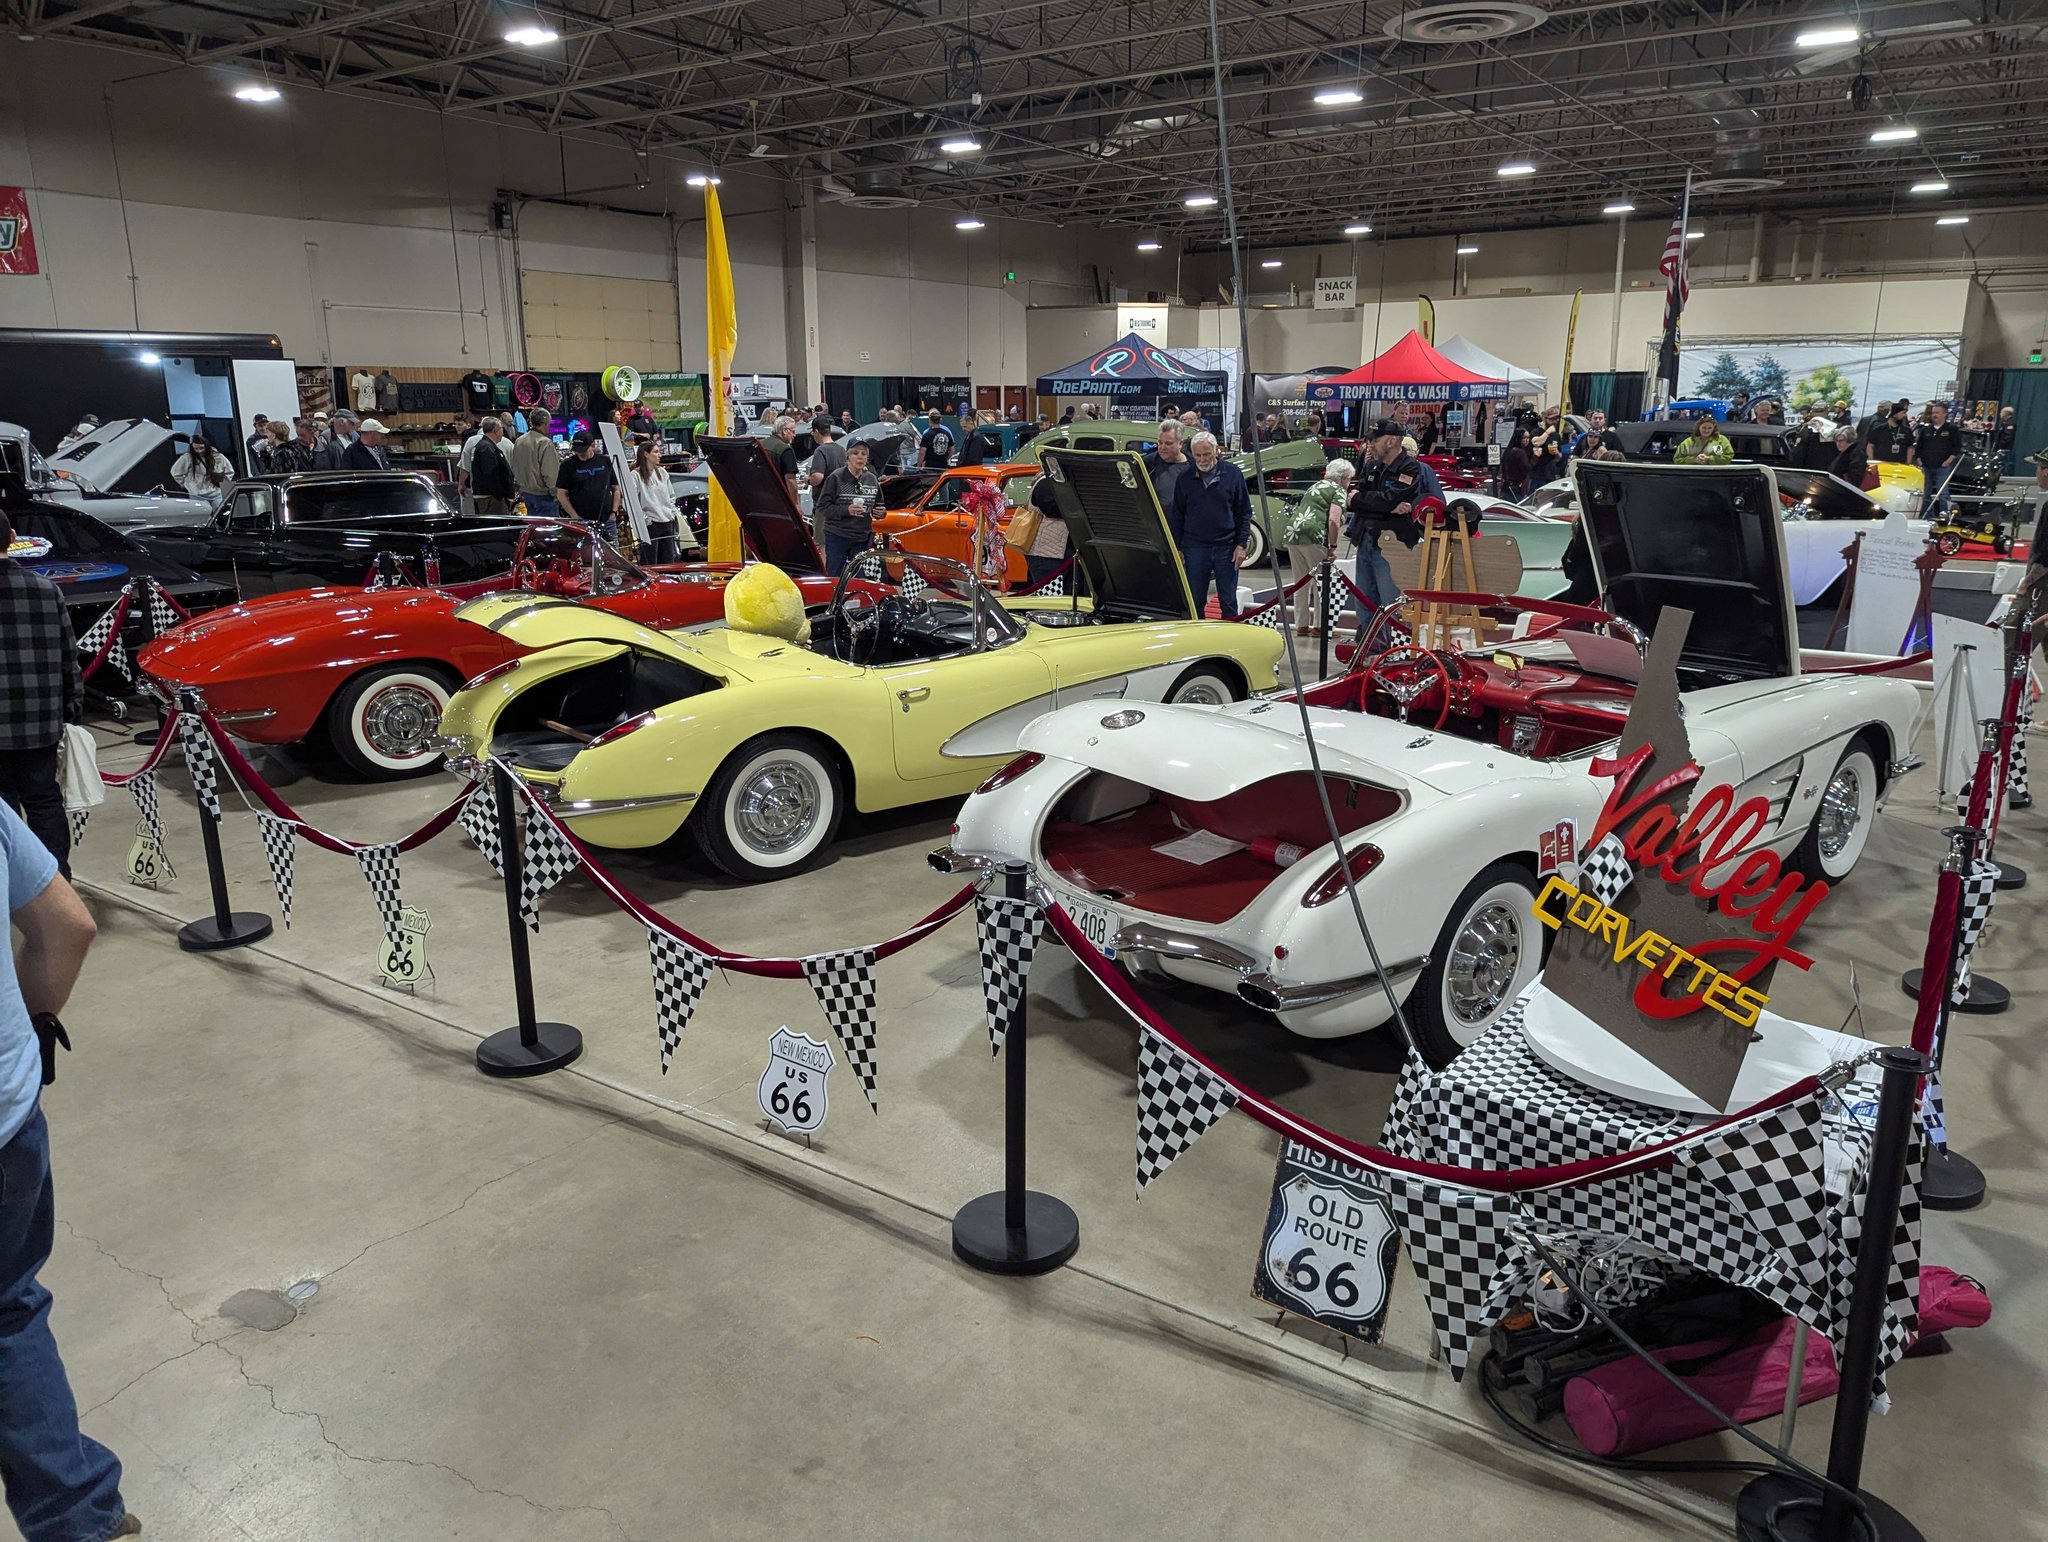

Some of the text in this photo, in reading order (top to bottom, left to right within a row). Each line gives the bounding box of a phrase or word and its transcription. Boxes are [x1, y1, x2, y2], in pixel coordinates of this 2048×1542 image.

[1318, 281, 1353, 291] SNACK
[1325, 292, 1345, 302] BAR
[1310, 399, 1326, 408] Prep
[1339, 383, 1450, 399] TROPHY FUEL & WASH
[1409, 404, 1440, 414] BRAND
[142, 840, 155, 850] US
[134, 852, 154, 876] 66
[1588, 743, 1830, 1019] Valley
[1070, 897, 1088, 910] IDAHO
[1080, 911, 1106, 944] 408
[387, 949, 414, 977] 66
[1531, 876, 1771, 1027] CORVETTES
[777, 1037, 826, 1068] NEW MEXICO
[784, 1066, 808, 1084] US
[770, 1081, 812, 1124] 66
[1286, 1139, 1385, 1190] HISTOR
[1308, 1194, 1364, 1230] OLD
[1294, 1216, 1368, 1258] ROUTE
[1287, 1247, 1360, 1308] 66
